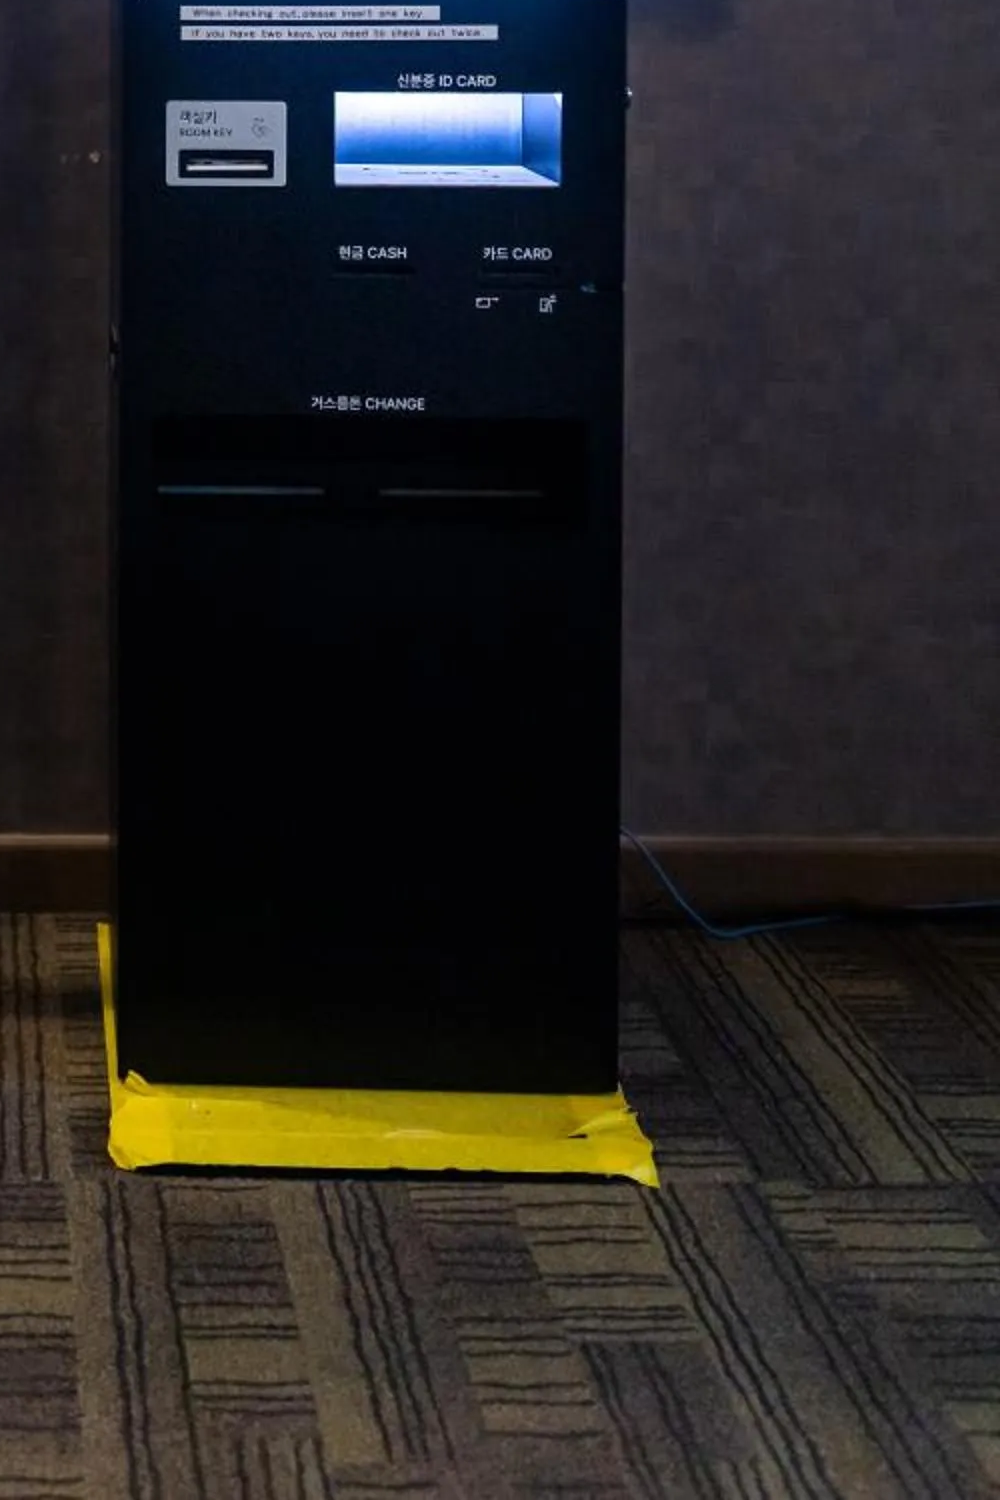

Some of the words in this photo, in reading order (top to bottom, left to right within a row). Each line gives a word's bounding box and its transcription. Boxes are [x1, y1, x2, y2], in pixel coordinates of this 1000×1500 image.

[205, 30, 225, 39] you
[229, 30, 256, 38] have
[261, 30, 283, 38] two
[397, 73, 436, 89] 신분증
[439, 75, 453, 88] ID
[456, 75, 497, 88] CARD
[213, 127, 233, 137] KEY
[338, 245, 363, 260] 현금
[367, 246, 407, 260] CASH
[483, 245, 509, 261] 카드
[512, 247, 553, 261] CARD
[364, 396, 426, 411] CHANGE
